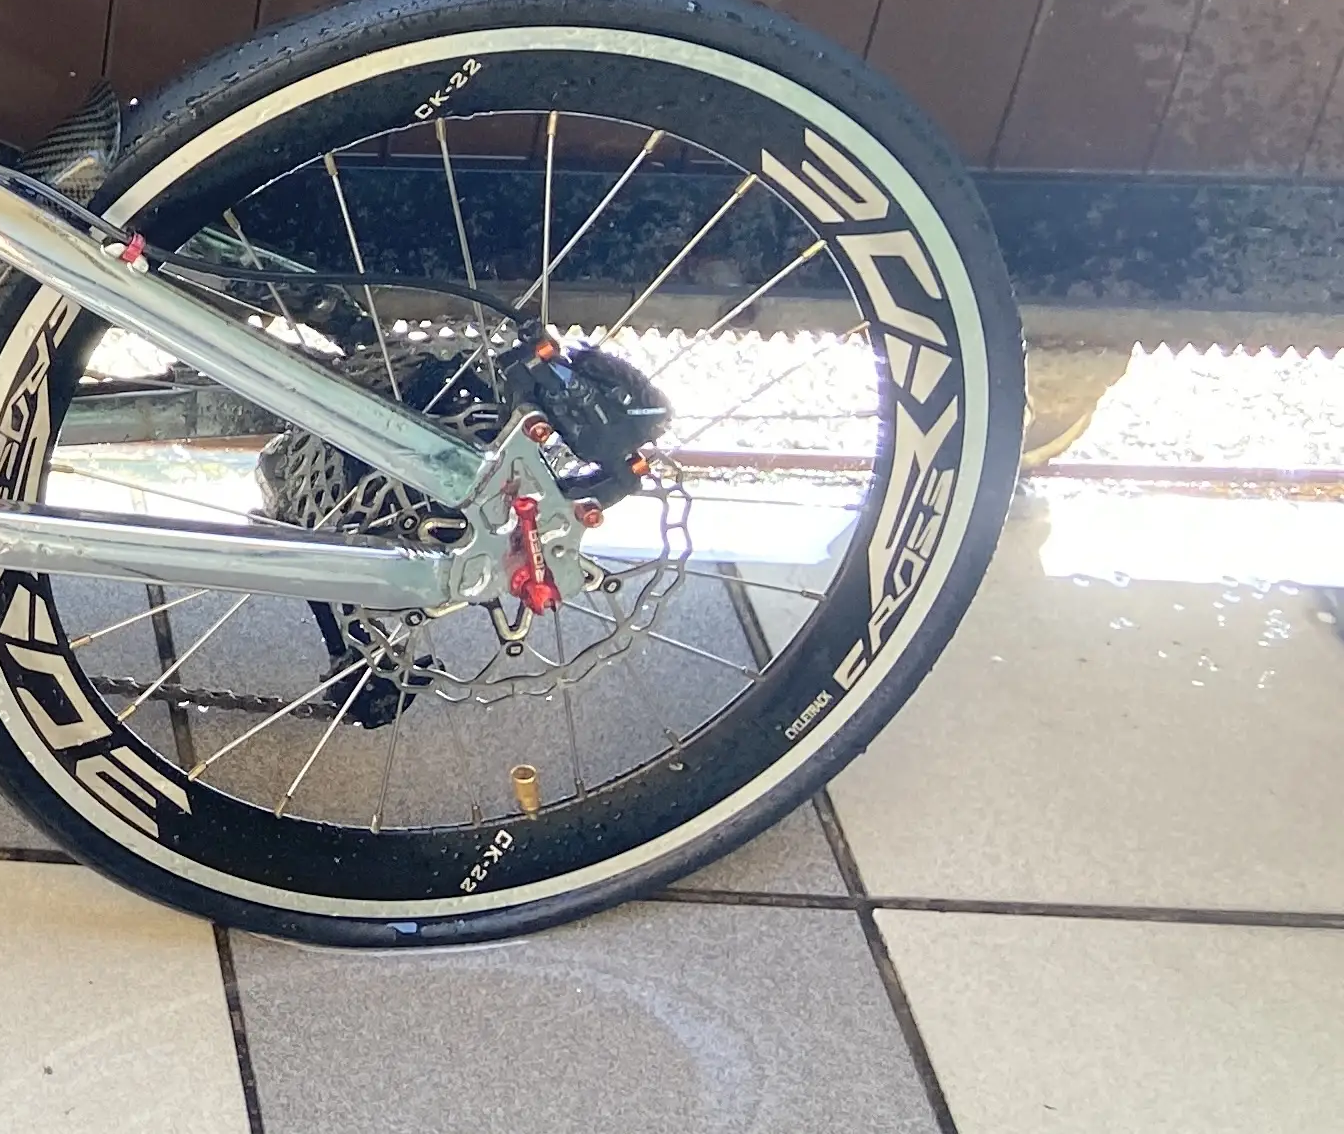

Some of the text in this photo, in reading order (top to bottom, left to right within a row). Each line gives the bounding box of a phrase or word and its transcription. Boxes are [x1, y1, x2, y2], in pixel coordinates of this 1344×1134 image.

[414, 57, 481, 120] CK-22
[784, 690, 833, 739] CYCLETRACK
[459, 829, 514, 893] CK-22
